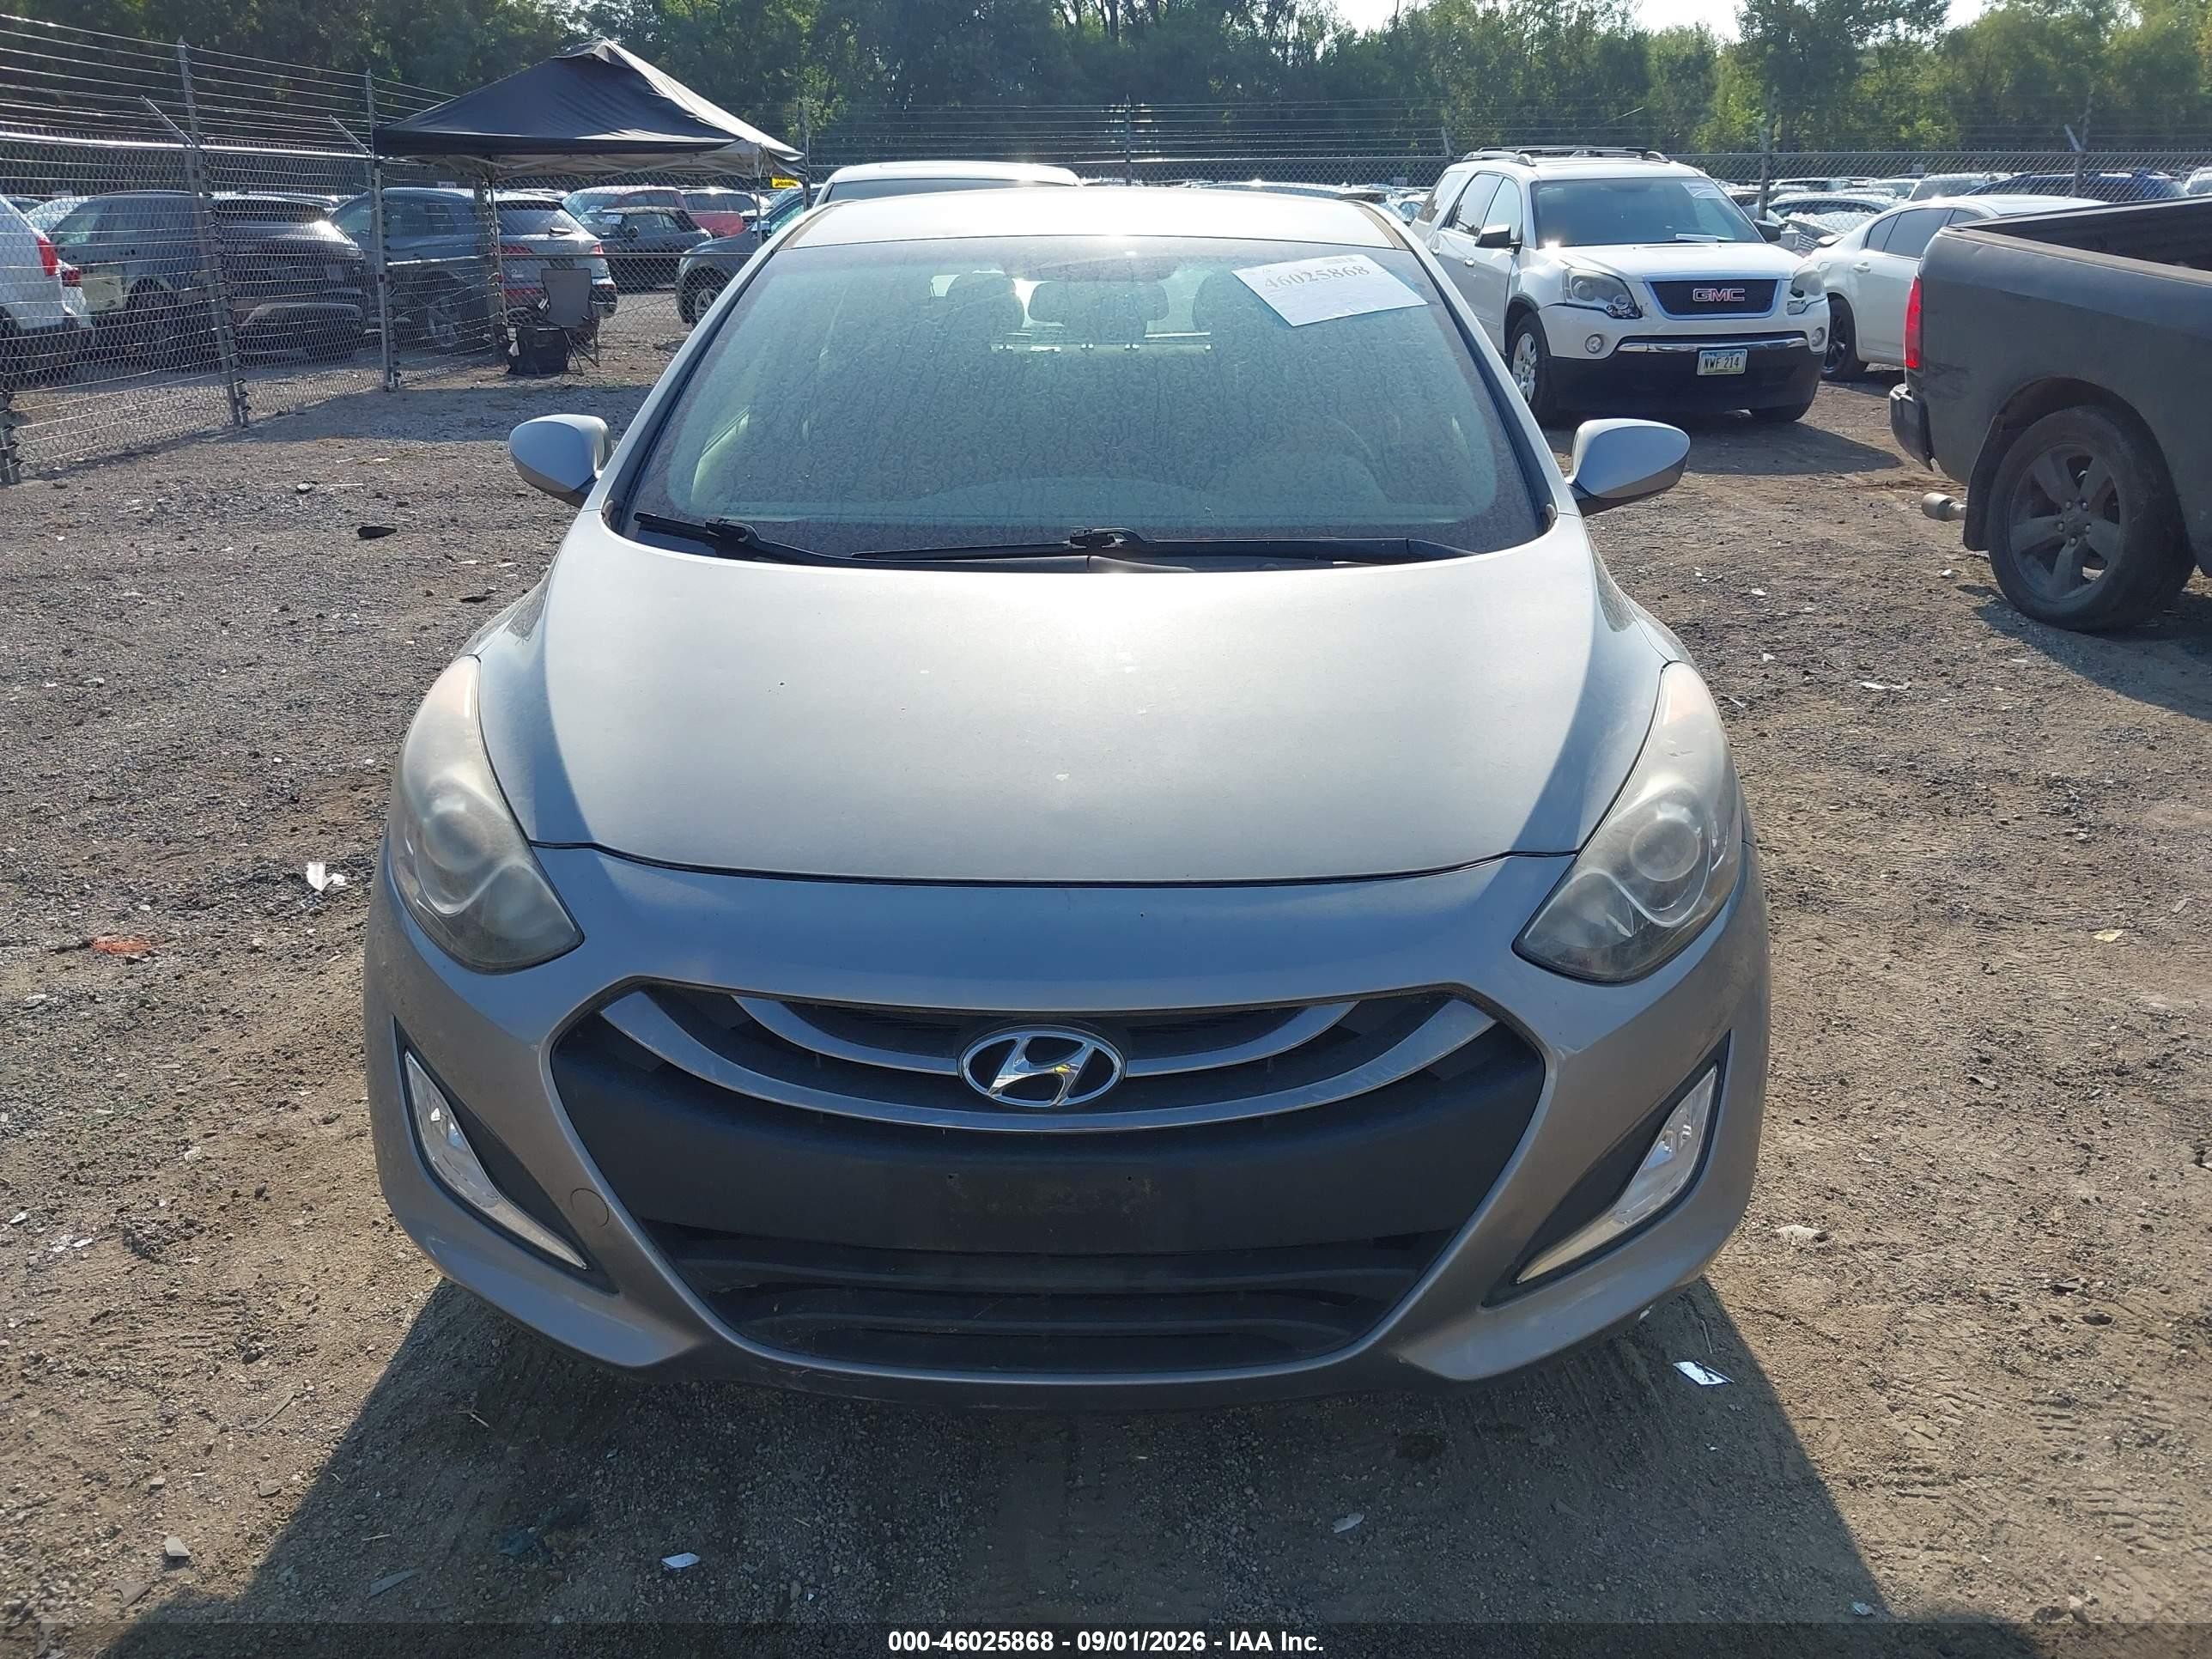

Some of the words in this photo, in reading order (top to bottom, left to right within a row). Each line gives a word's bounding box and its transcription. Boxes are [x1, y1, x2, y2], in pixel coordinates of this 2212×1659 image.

[1265, 265, 1370, 288] 46025868
[1692, 288, 1745, 302] GMC
[1704, 357, 1722, 369] NWF
[1723, 356, 1740, 368] 214
